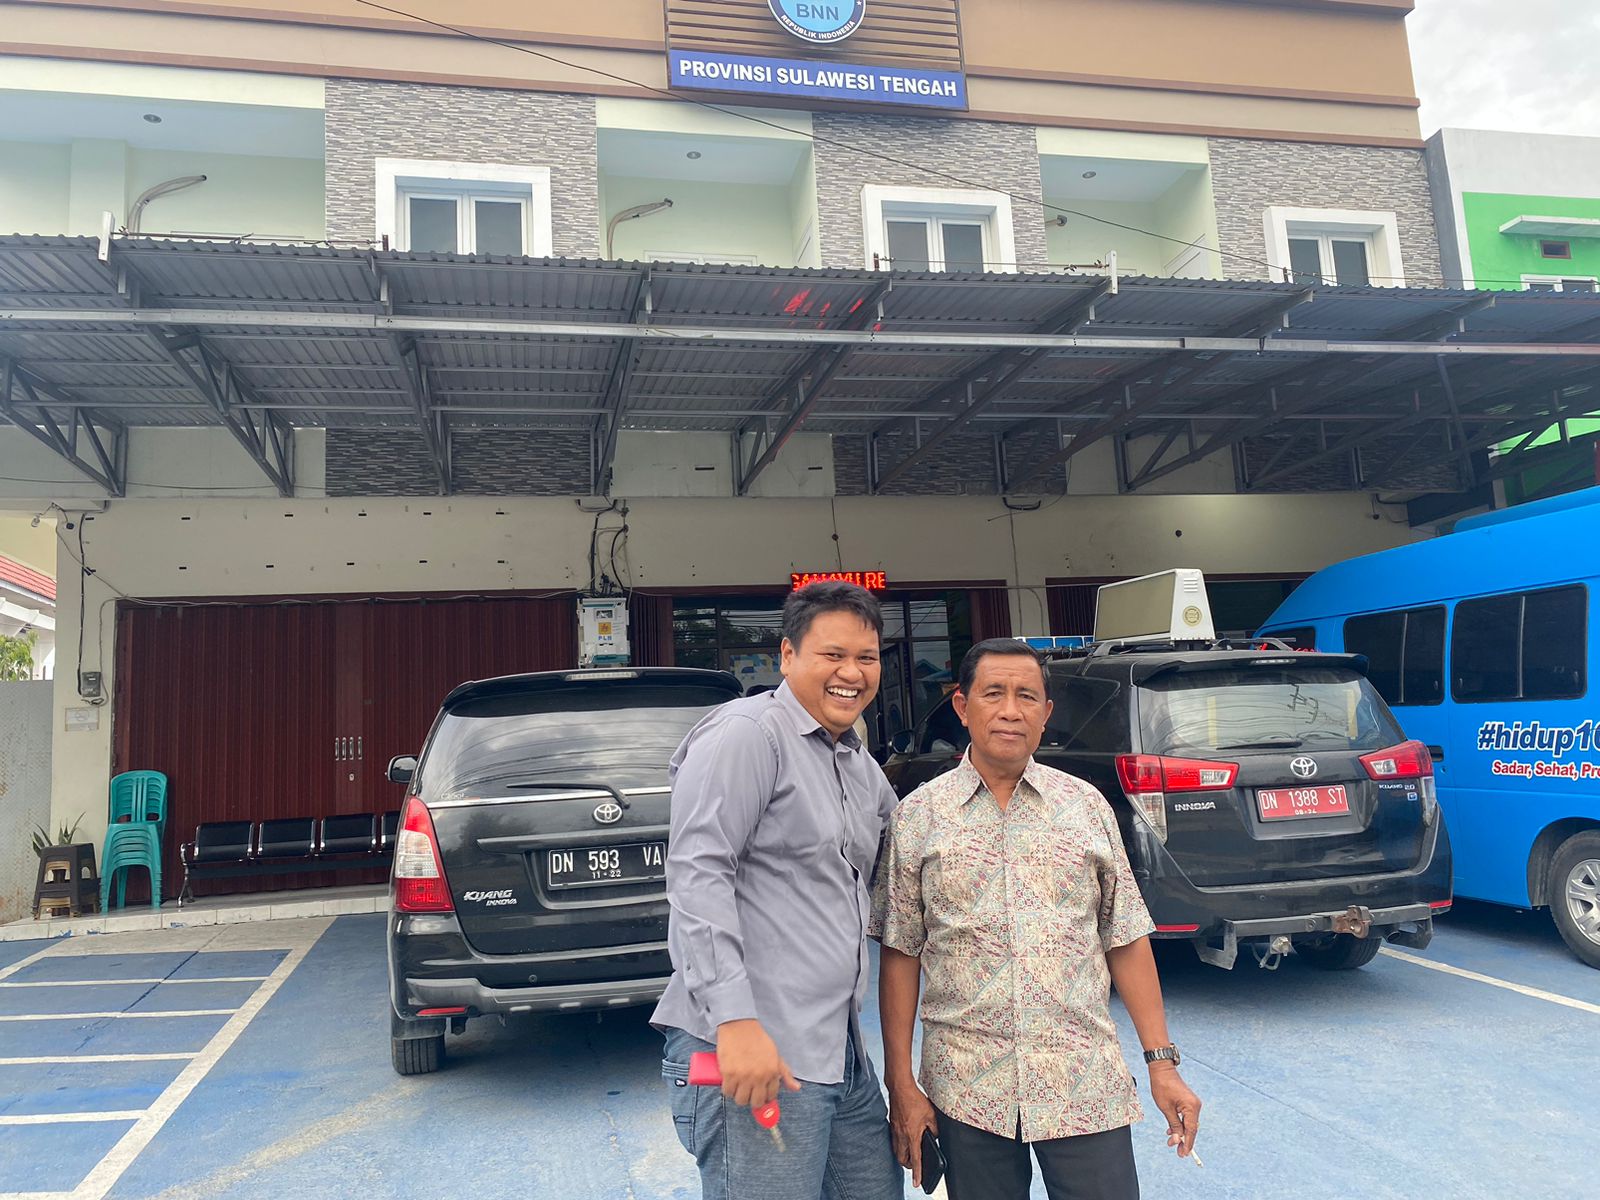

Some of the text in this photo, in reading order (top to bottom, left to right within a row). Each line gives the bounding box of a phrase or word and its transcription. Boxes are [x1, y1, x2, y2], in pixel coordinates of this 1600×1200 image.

[796, 3, 839, 20] BNN
[780, 14, 856, 40] REPUBLIK INDONESIA
[679, 59, 958, 97] PROVINSI SULAWESI TENGAH
[1492, 760, 1533, 779] Sadar,
[1534, 761, 1579, 781] Sehat,
[1174, 801, 1216, 812] INNOVA
[1260, 787, 1343, 810] DN 1388 ST
[552, 846, 662, 874] DN 593 VA
[463, 889, 513, 902] KIJANG
[485, 898, 518, 906] INNOVA
